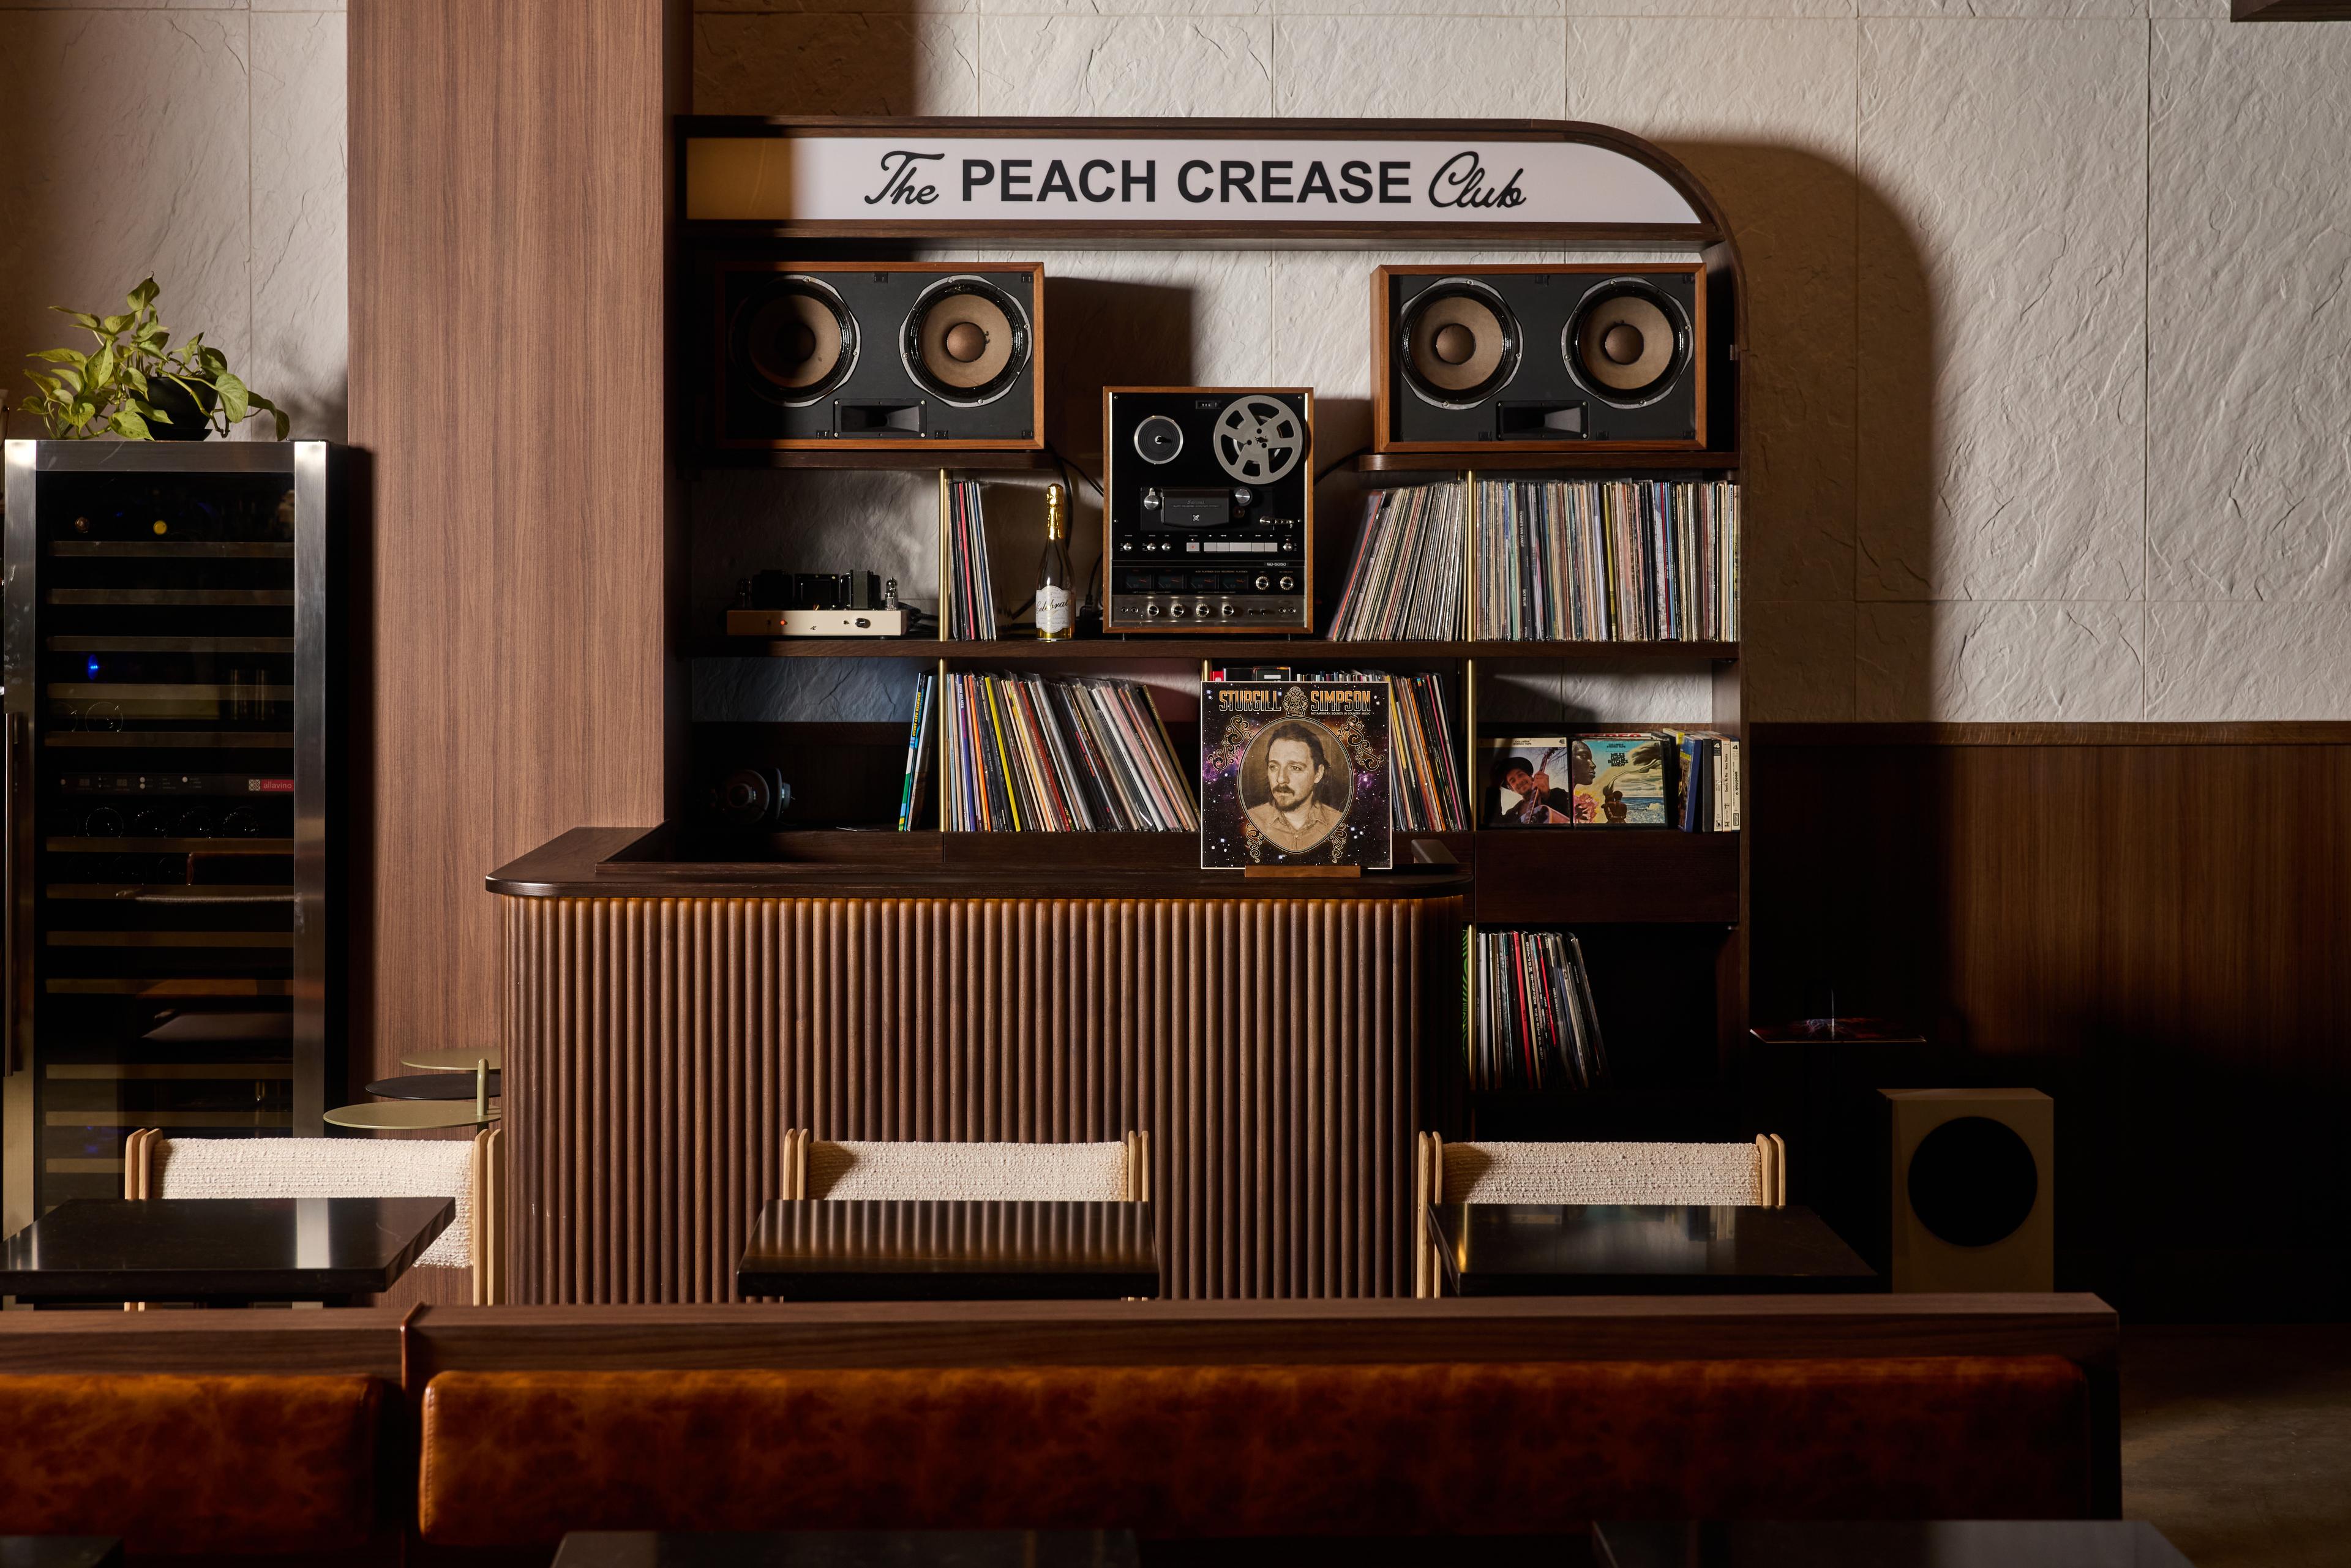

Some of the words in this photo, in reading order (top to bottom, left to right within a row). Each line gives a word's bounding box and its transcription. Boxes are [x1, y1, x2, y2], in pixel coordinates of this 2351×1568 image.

[864, 150, 945, 205] The
[962, 159, 1156, 203] PEACH
[1177, 160, 1411, 204] CREASE
[1429, 151, 1526, 208] Club
[1219, 690, 1282, 711] STURGILL
[1310, 690, 1371, 711] SIMPSON
